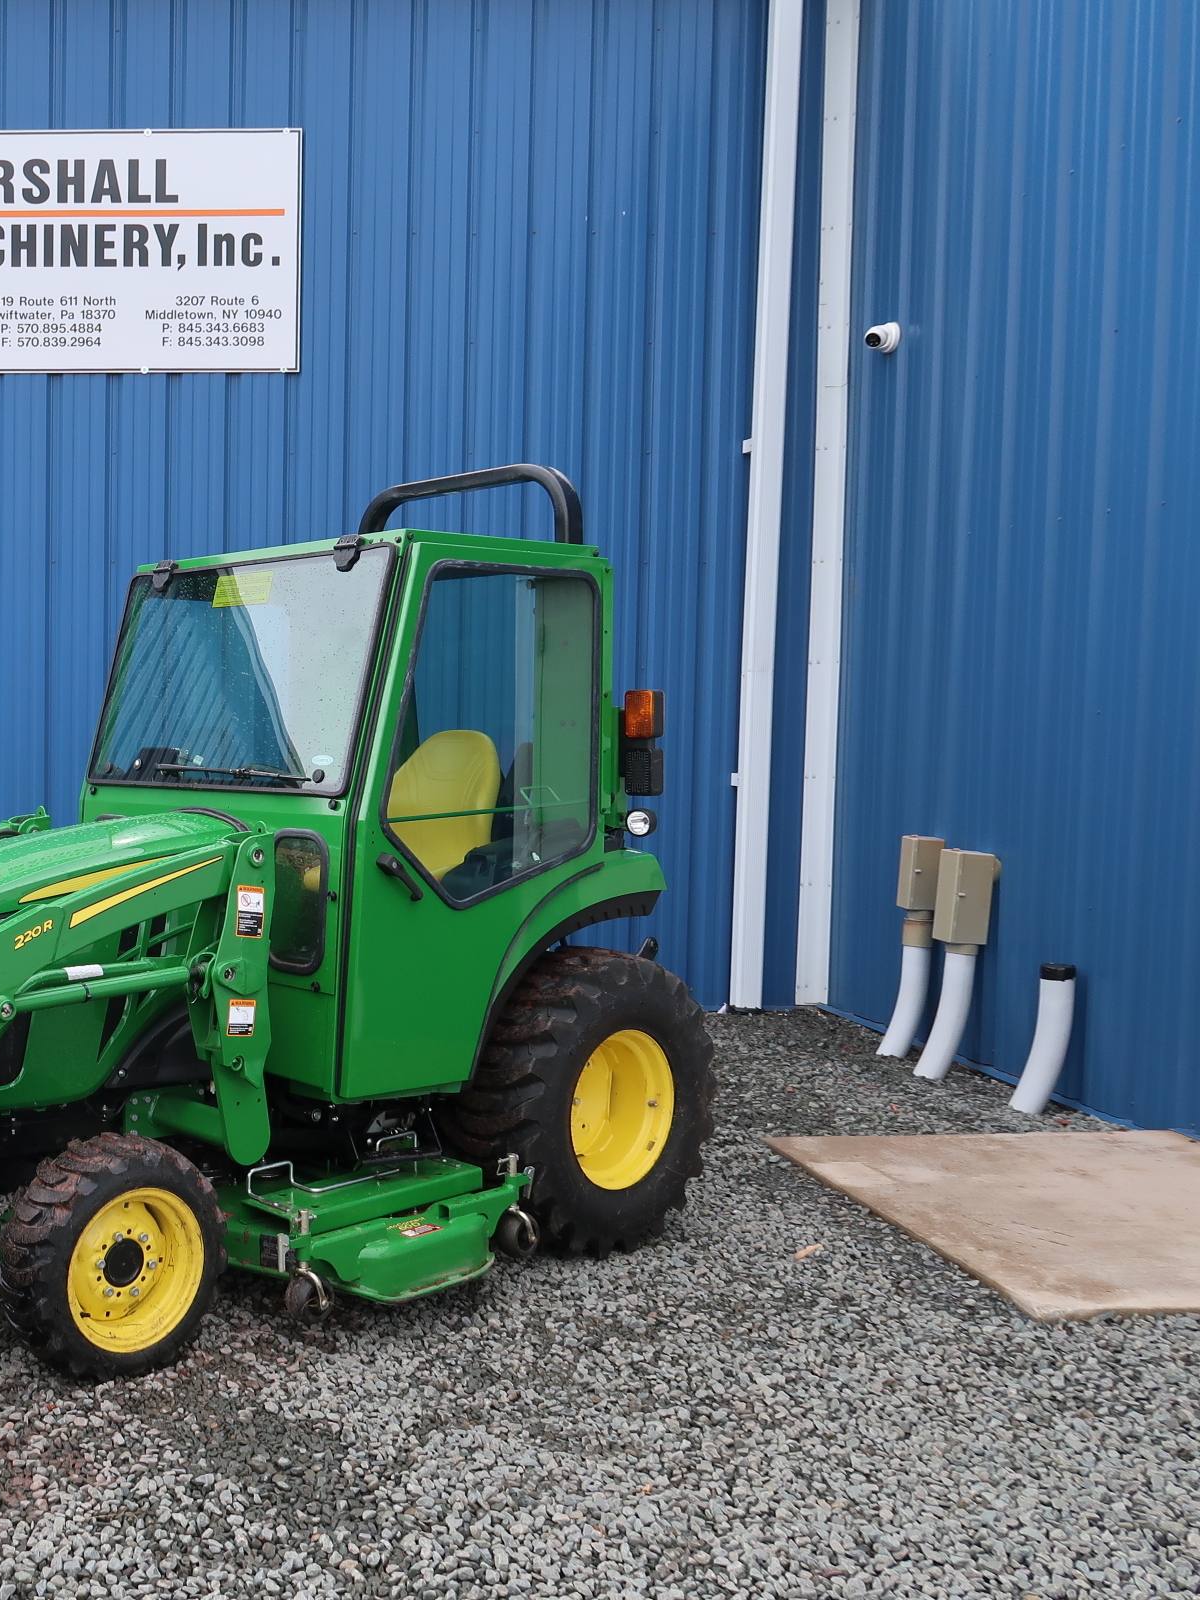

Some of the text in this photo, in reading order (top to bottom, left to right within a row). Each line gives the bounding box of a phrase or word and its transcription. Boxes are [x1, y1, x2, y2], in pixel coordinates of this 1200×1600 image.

[197, 223, 280, 267] Inc.
[19, 296, 55, 307] Route
[59, 295, 78, 307] 611
[83, 295, 116, 307] North
[175, 295, 260, 307] 3207 Route 6
[60, 309, 75, 320] Pa
[80, 309, 116, 320] 18370
[145, 308, 282, 321] Middletown, NY 10940
[0, 322, 103, 334] P: 570.895.4884
[162, 322, 265, 334] P: 845.343.6683
[1, 336, 102, 348] F: 570.839.2964
[162, 335, 265, 347] F: 845.343.3098
